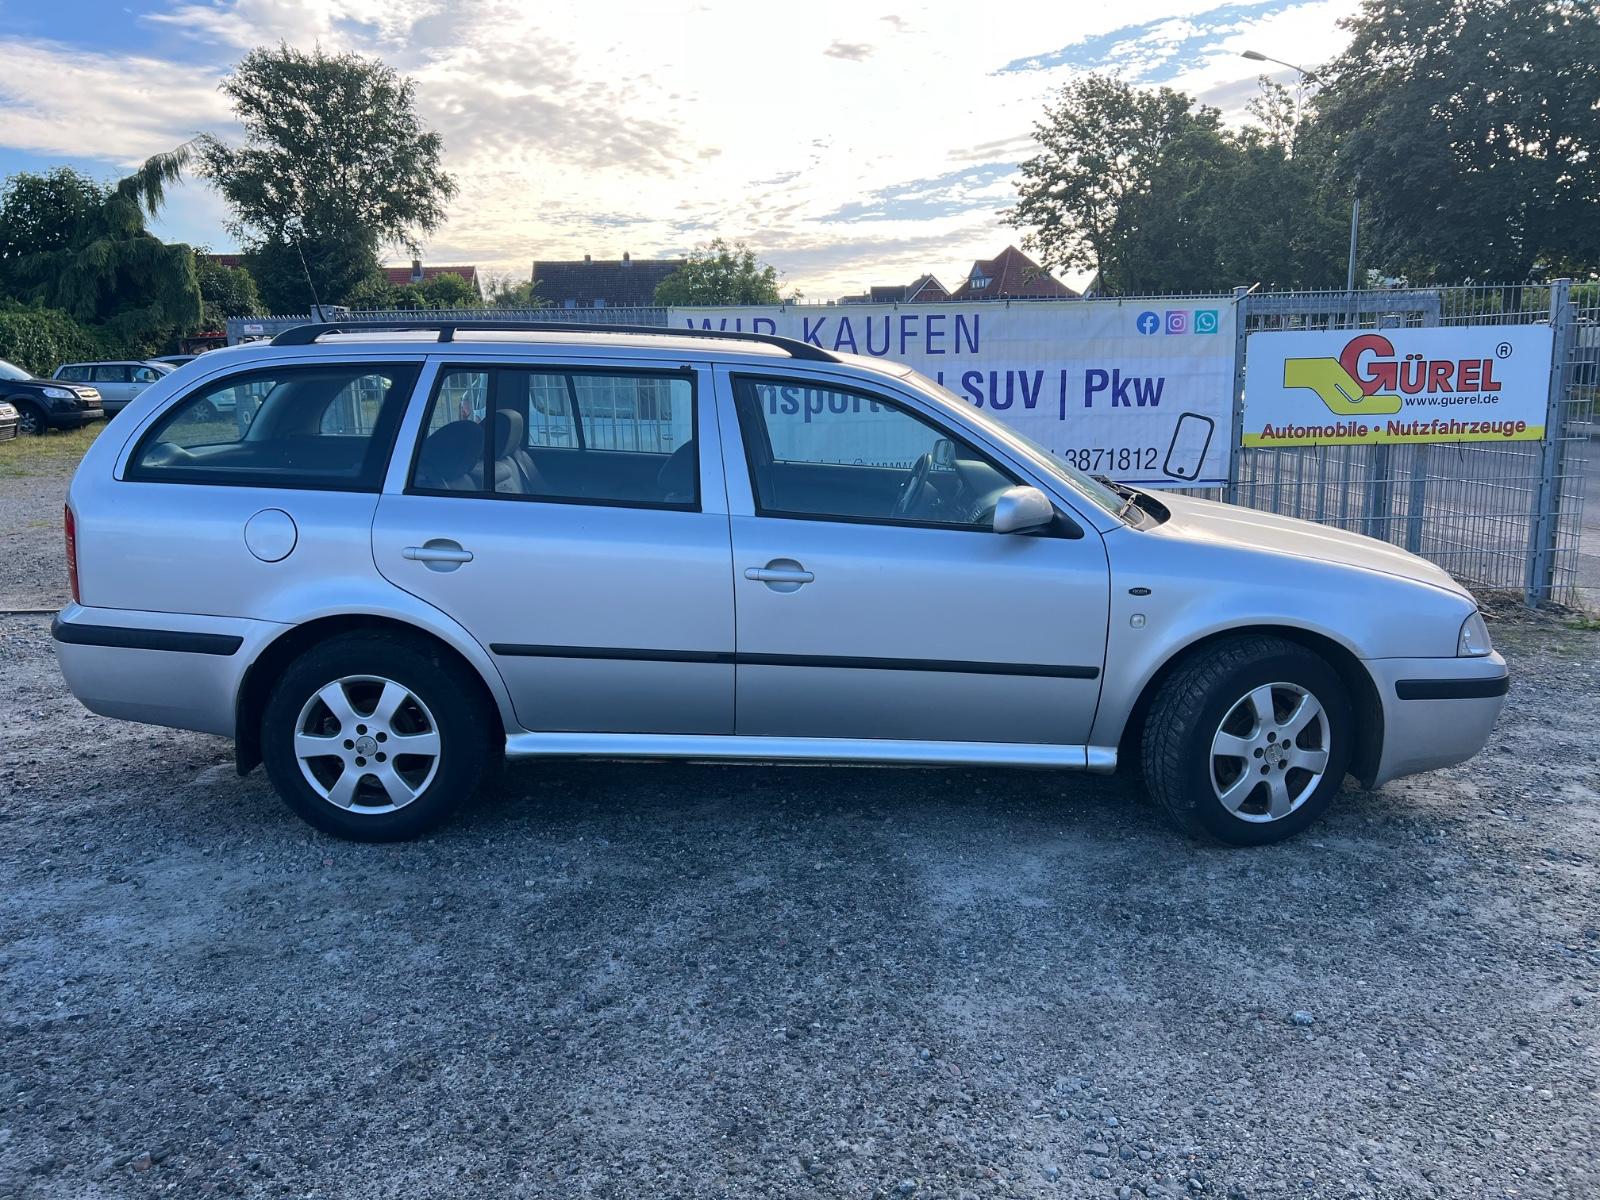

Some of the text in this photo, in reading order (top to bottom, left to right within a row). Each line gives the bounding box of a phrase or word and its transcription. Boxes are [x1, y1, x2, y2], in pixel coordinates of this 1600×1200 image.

[803, 314, 979, 356] KAUFEN
[1339, 334, 1501, 395] GÜREL
[961, 370, 1044, 410] SUV
[1084, 368, 1165, 408] Pkw
[1405, 393, 1499, 408] www.guerel.de
[1260, 418, 1526, 440] Automobile Nutzfahrzeuge
[1065, 447, 1158, 471] 3871812
